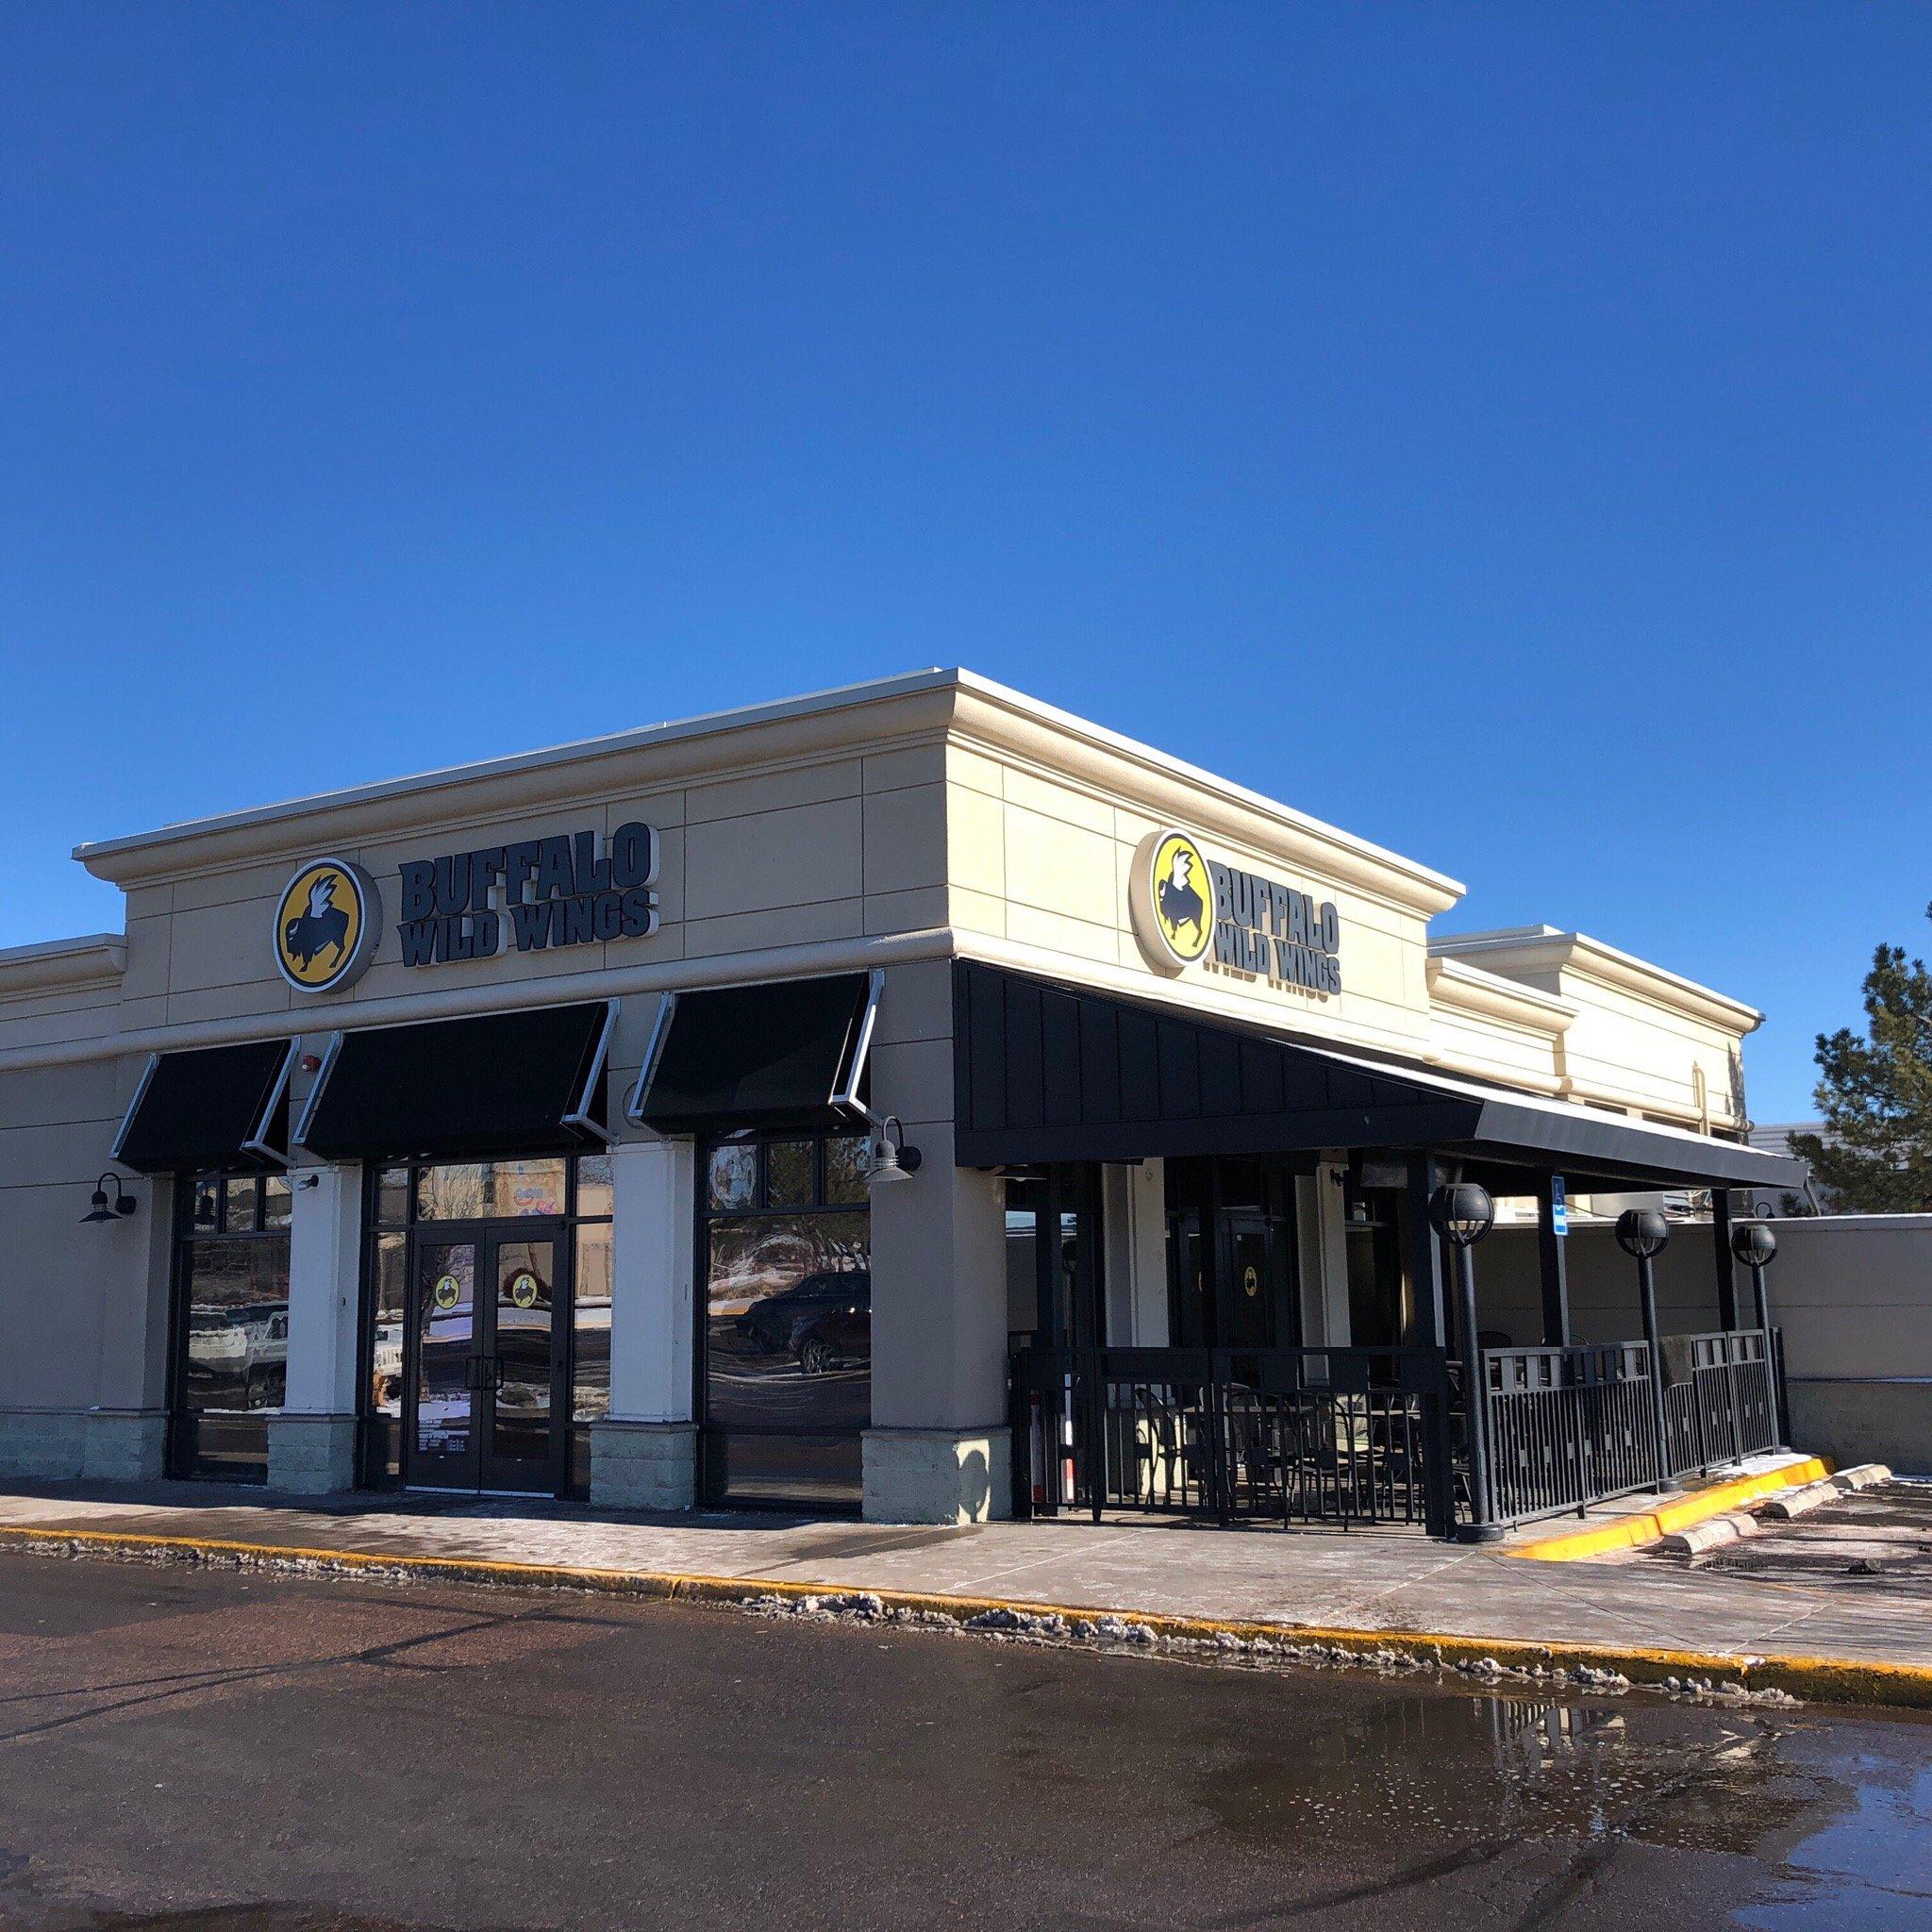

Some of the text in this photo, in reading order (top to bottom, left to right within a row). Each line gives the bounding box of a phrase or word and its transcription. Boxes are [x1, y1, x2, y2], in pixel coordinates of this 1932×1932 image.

[398, 822, 654, 922] BUFFALO
[1207, 859, 1340, 955] BUFFALO
[396, 888, 653, 968] WILD WINGS
[1214, 920, 1341, 995] WILD WINGS
